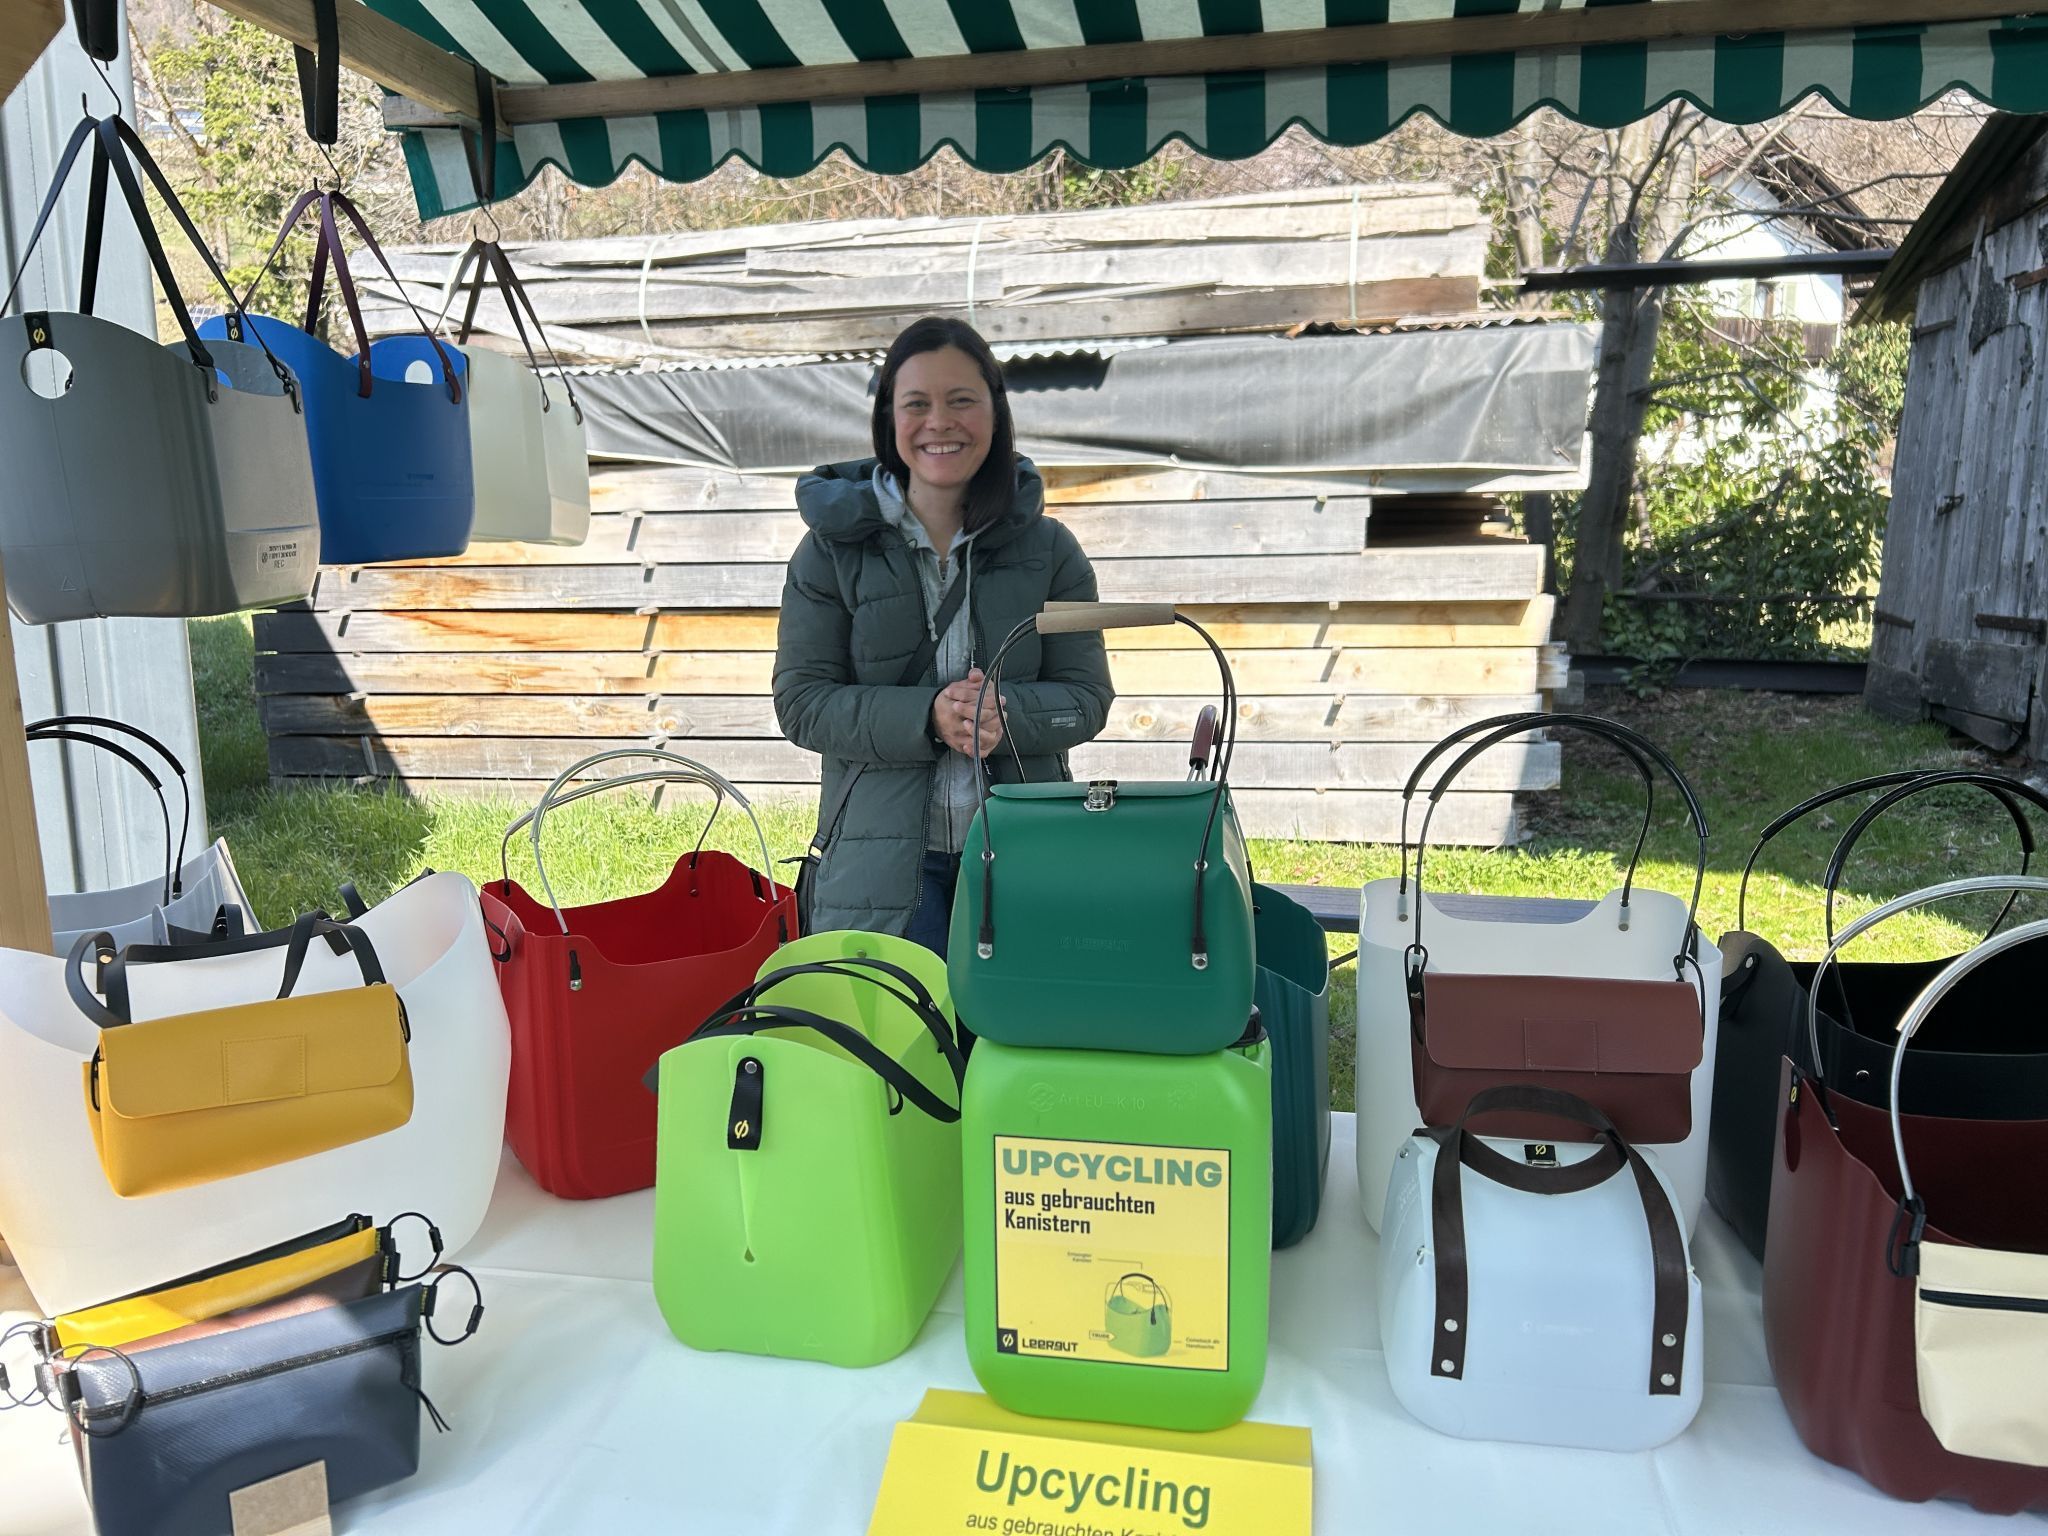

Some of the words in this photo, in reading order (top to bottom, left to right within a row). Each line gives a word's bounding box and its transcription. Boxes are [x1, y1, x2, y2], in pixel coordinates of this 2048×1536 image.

[1002, 1148, 1223, 1188] UPCYCLING
[1004, 1190, 1035, 1207] aus
[1041, 1188, 1156, 1215] gebrauchten
[1004, 1208, 1091, 1234] Kanistern
[976, 1449, 1211, 1529] Upcycling
[965, 1513, 998, 1530] aus
